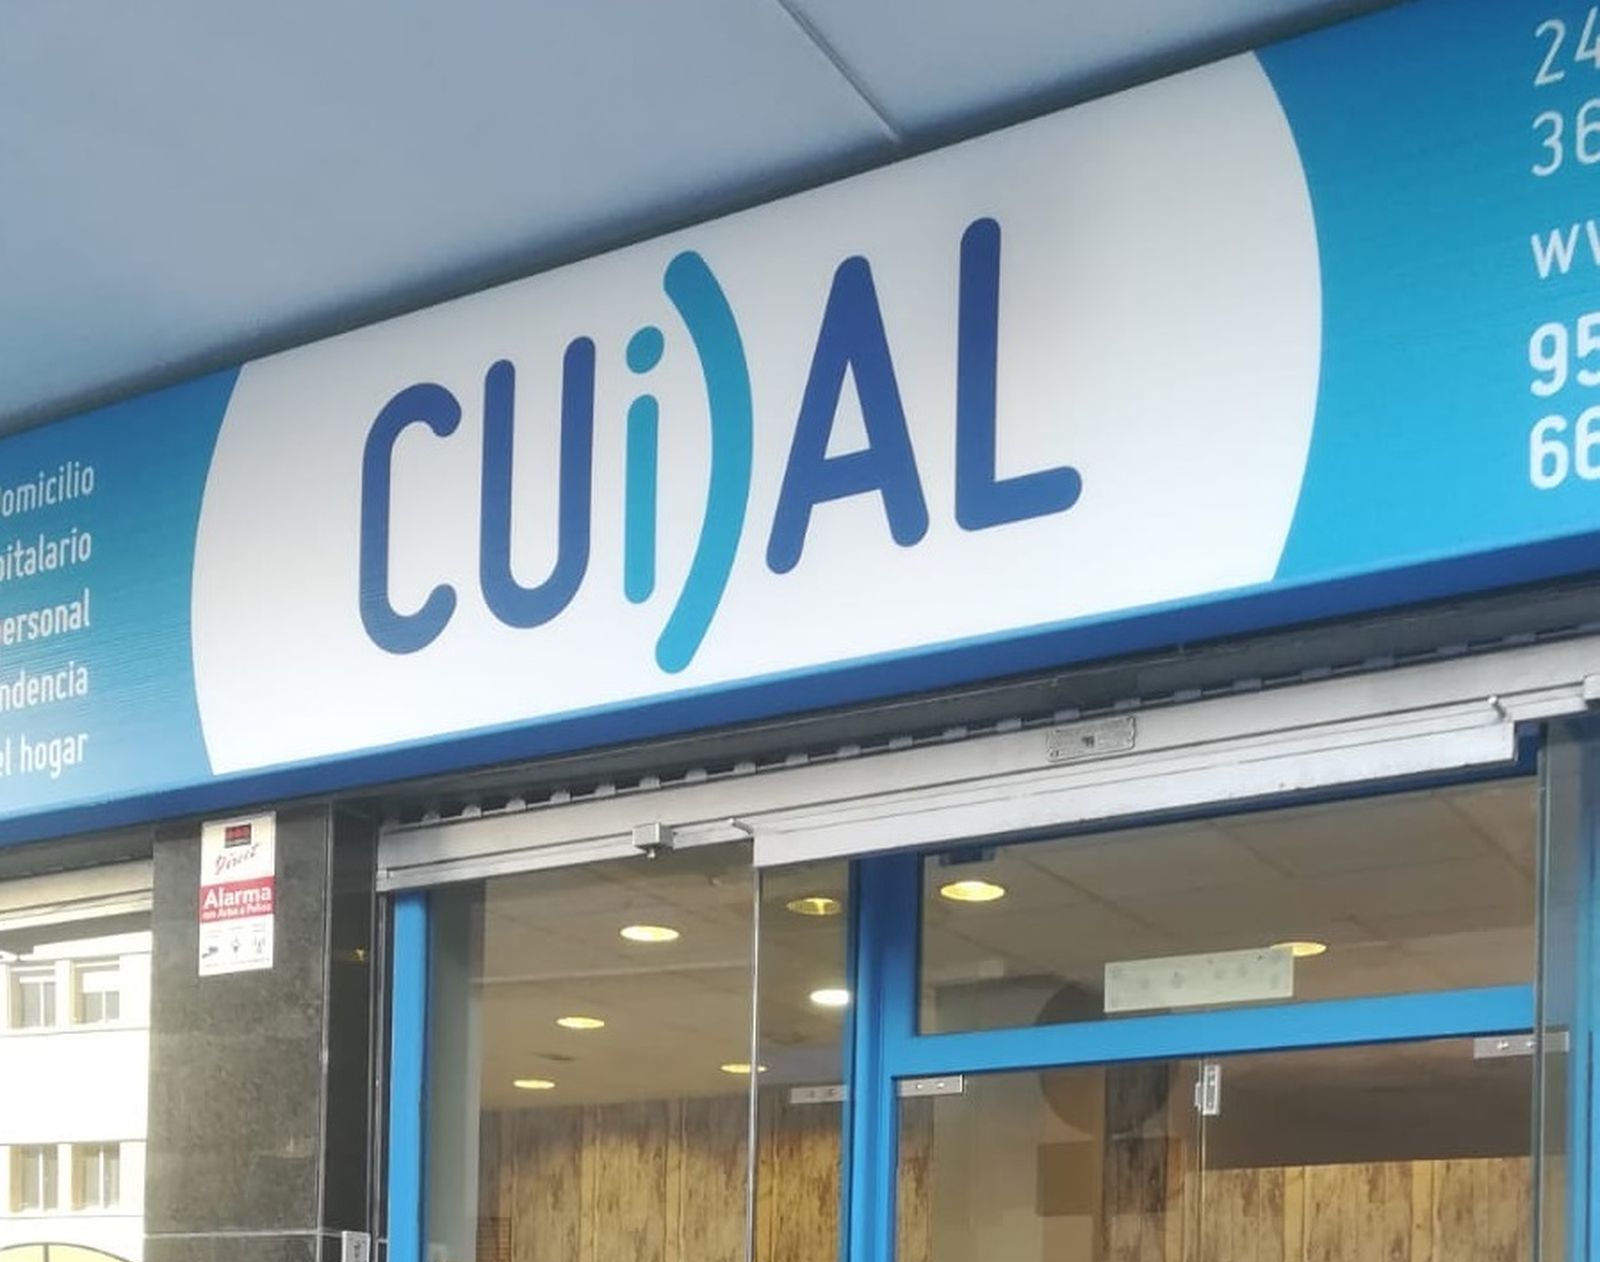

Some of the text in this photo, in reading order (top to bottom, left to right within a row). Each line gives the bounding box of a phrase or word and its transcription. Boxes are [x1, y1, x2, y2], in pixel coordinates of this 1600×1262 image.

[0, 461, 95, 517] omicilio
[0, 587, 91, 646] ersonal
[20, 733, 89, 780] hogar
[203, 886, 272, 909] Alarma
